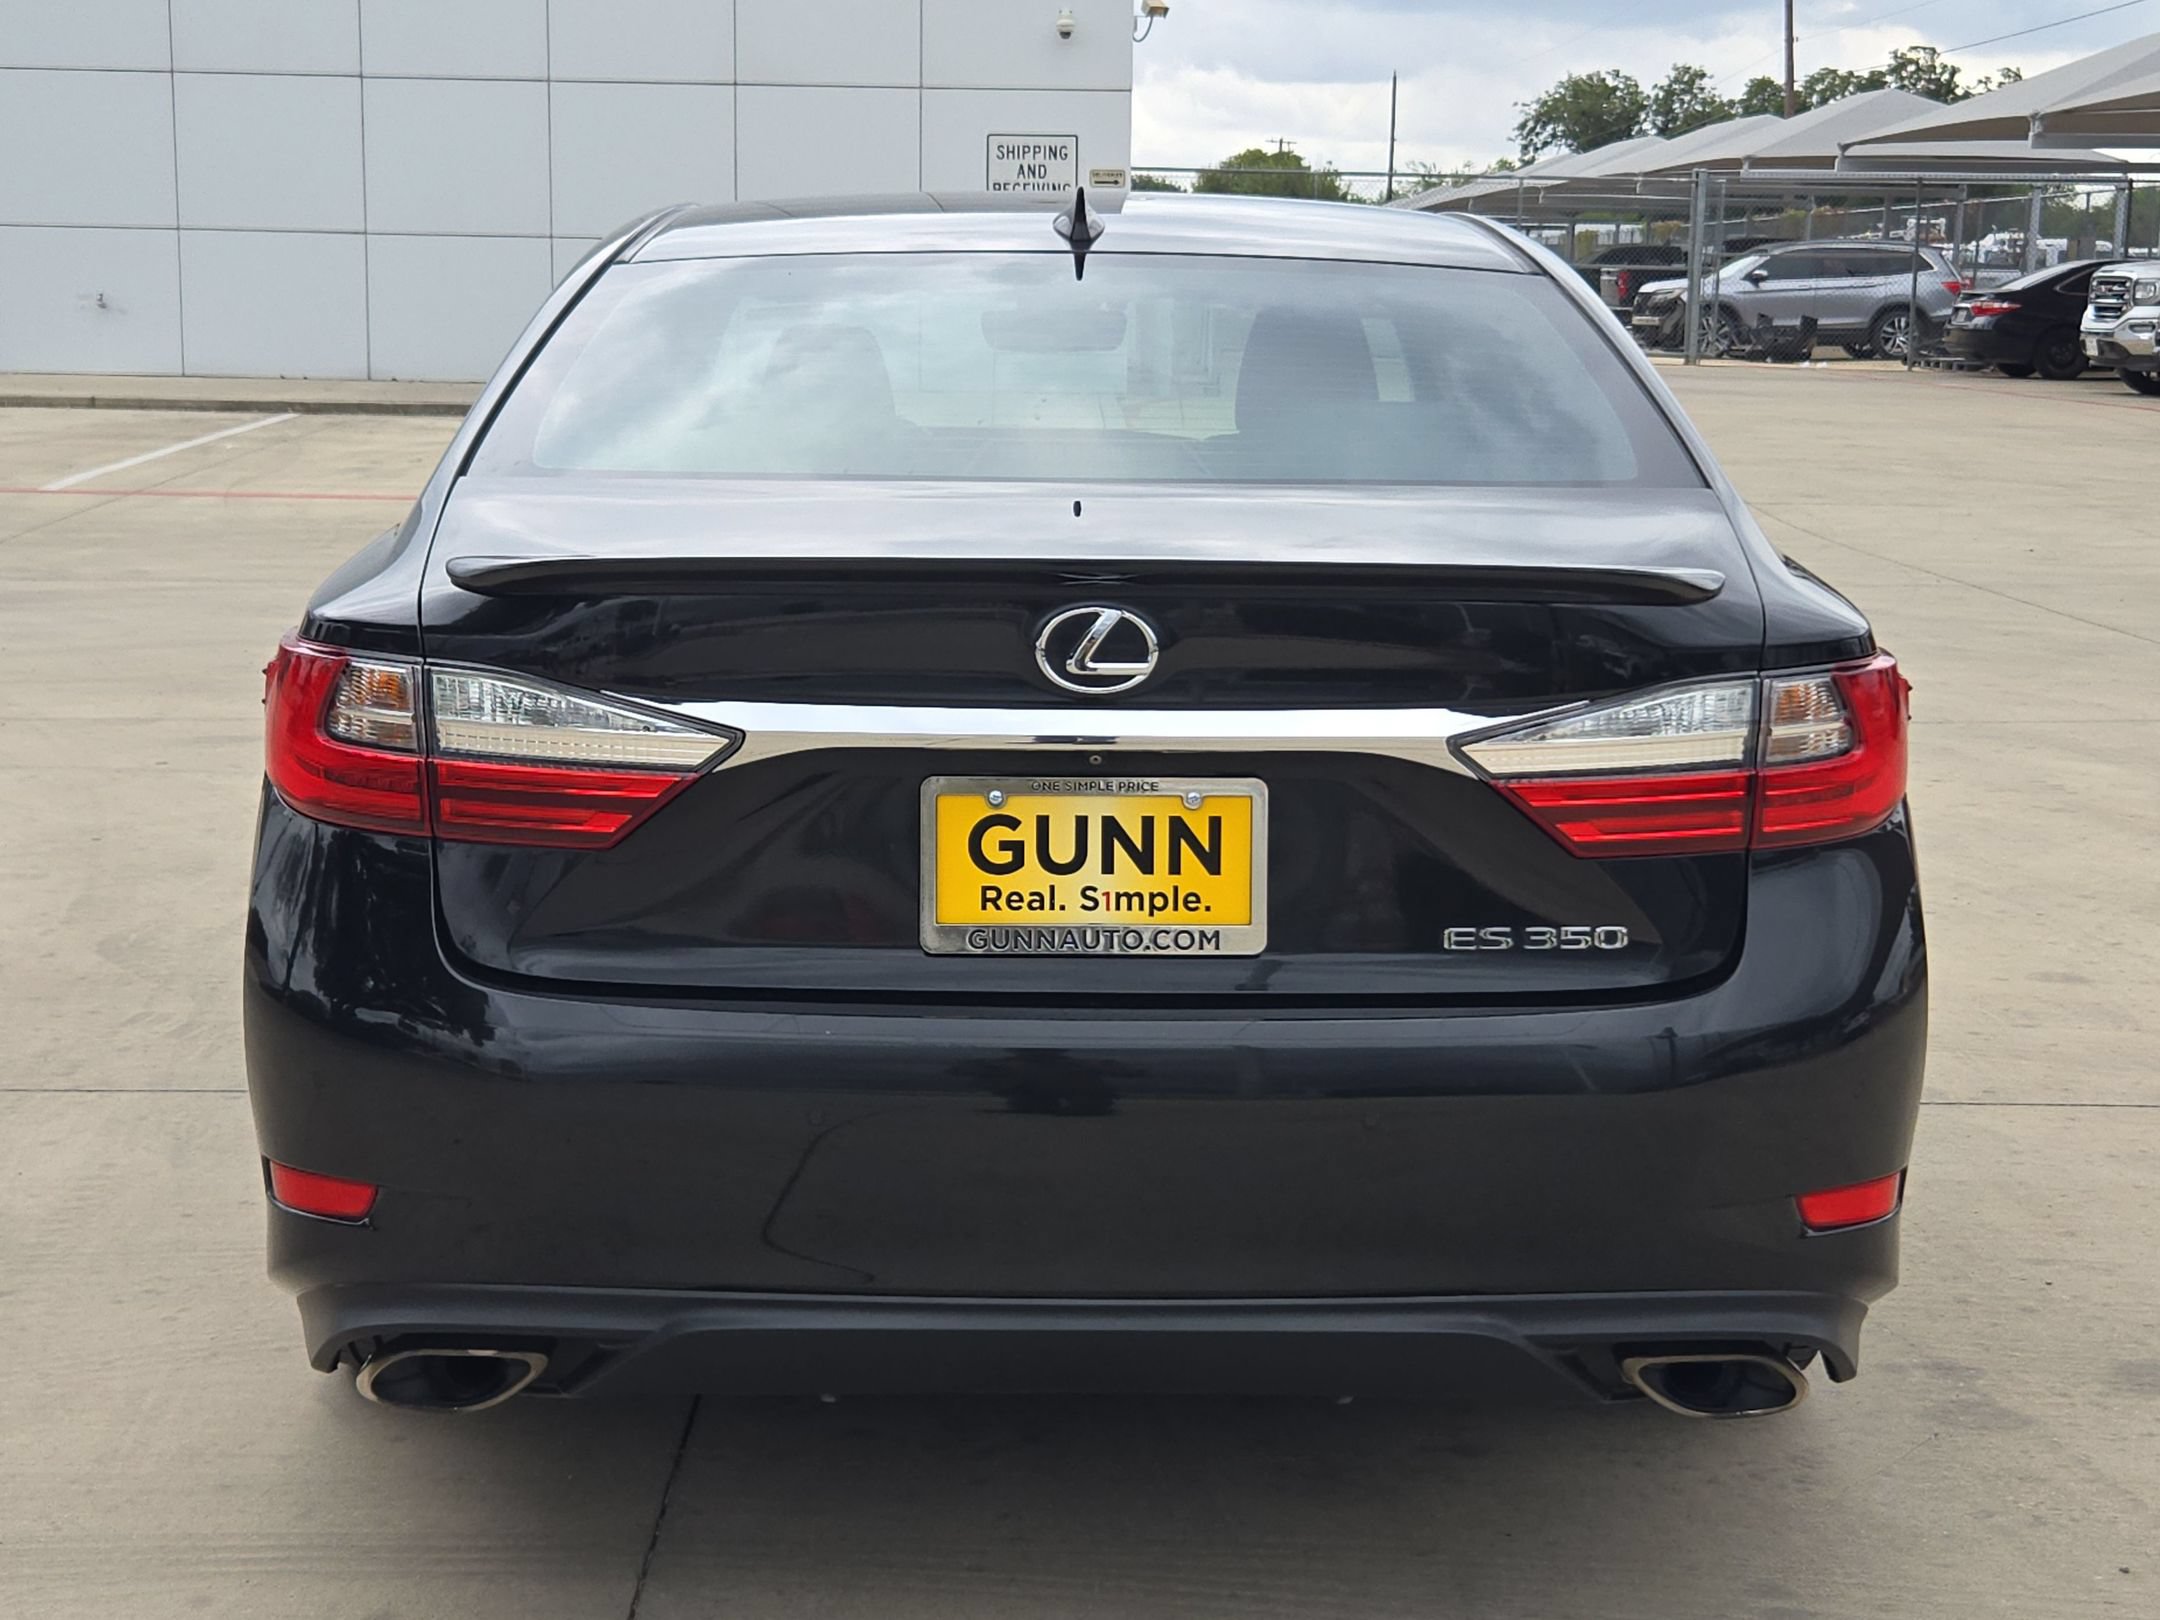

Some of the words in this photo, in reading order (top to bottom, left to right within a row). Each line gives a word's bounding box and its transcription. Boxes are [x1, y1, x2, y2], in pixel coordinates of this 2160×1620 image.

[996, 145, 1069, 161] SHIPPING
[1016, 163, 1047, 179] AND
[1031, 781, 1060, 792] ONE
[1065, 781, 1114, 792] SIMPLE
[1119, 781, 1159, 792] PRICE
[967, 813, 1222, 876] GUNN
[980, 885, 1066, 911] Real.
[1079, 885, 1212, 917] S1mple.
[967, 929, 1221, 952] GUNNAUTO.COM
[1443, 927, 1514, 950] ES
[1523, 926, 1629, 950] 350
